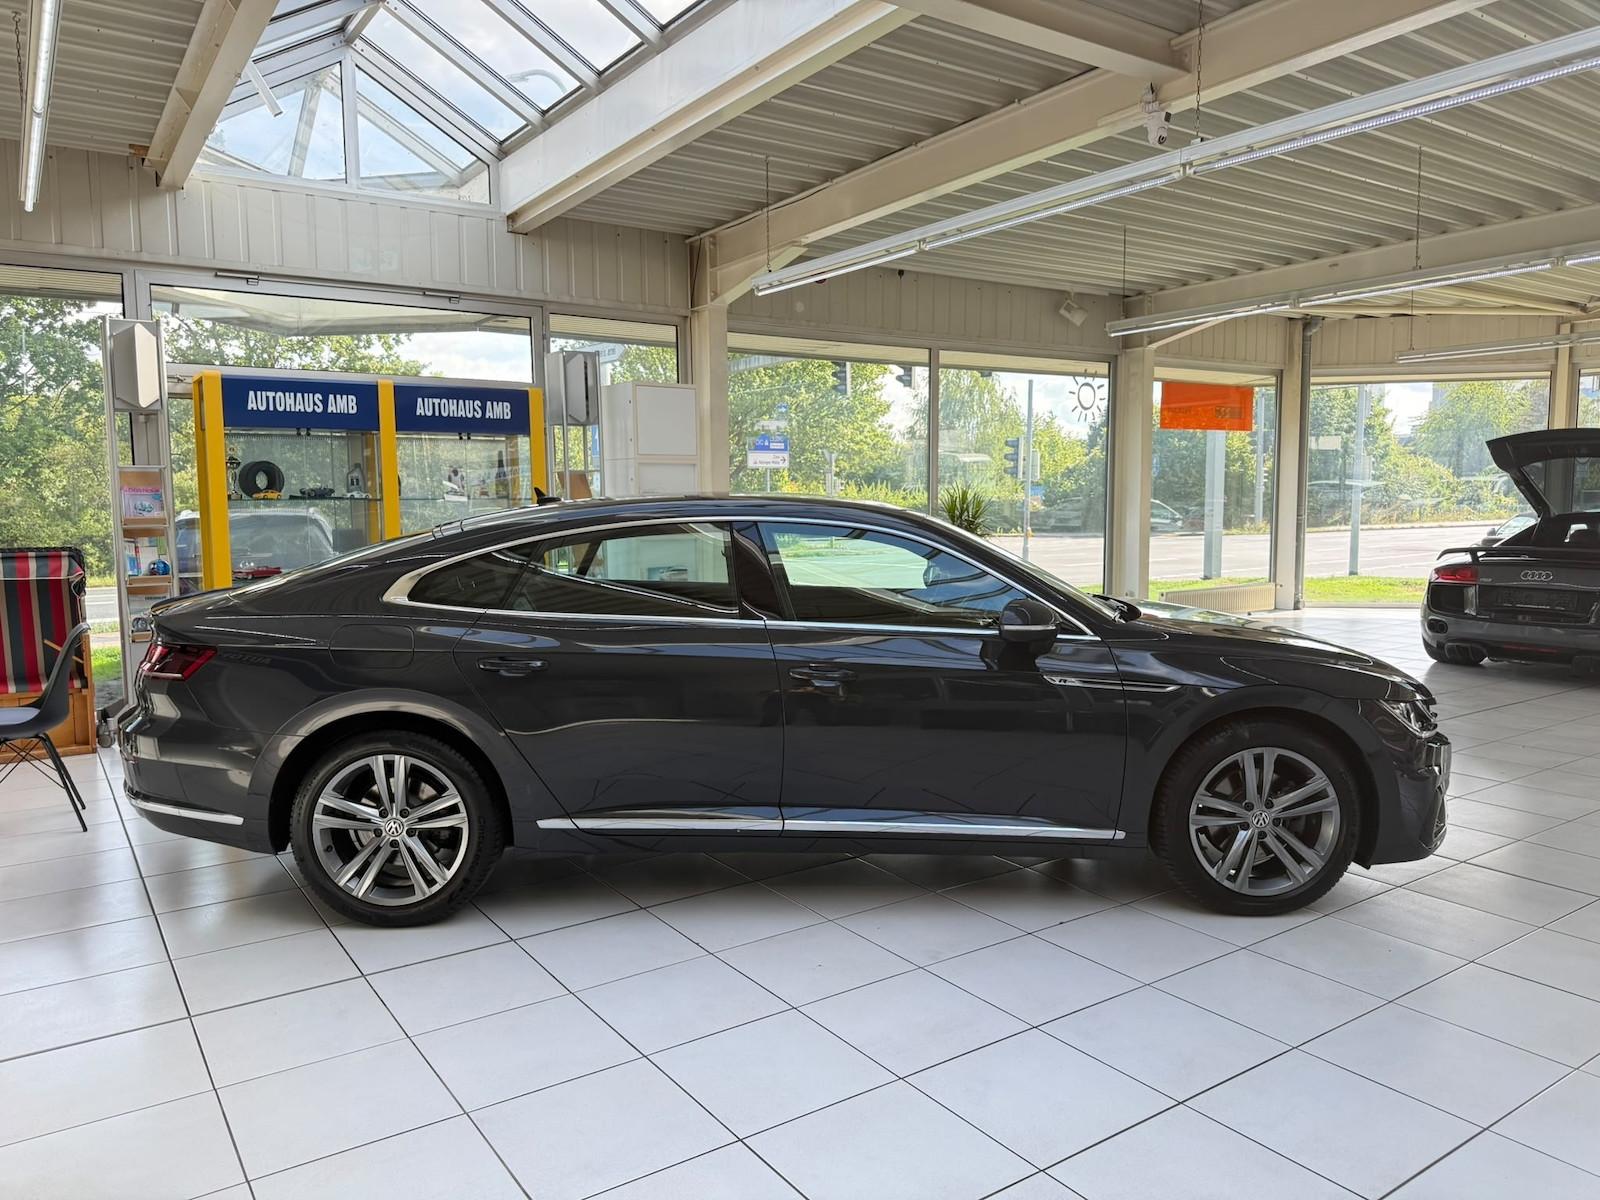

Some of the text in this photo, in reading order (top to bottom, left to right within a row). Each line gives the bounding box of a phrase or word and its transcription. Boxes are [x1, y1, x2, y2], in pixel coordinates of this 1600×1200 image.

[247, 390, 358, 414] AUTOHAUS AMB
[416, 397, 512, 420] AUTOHAUS AMB
